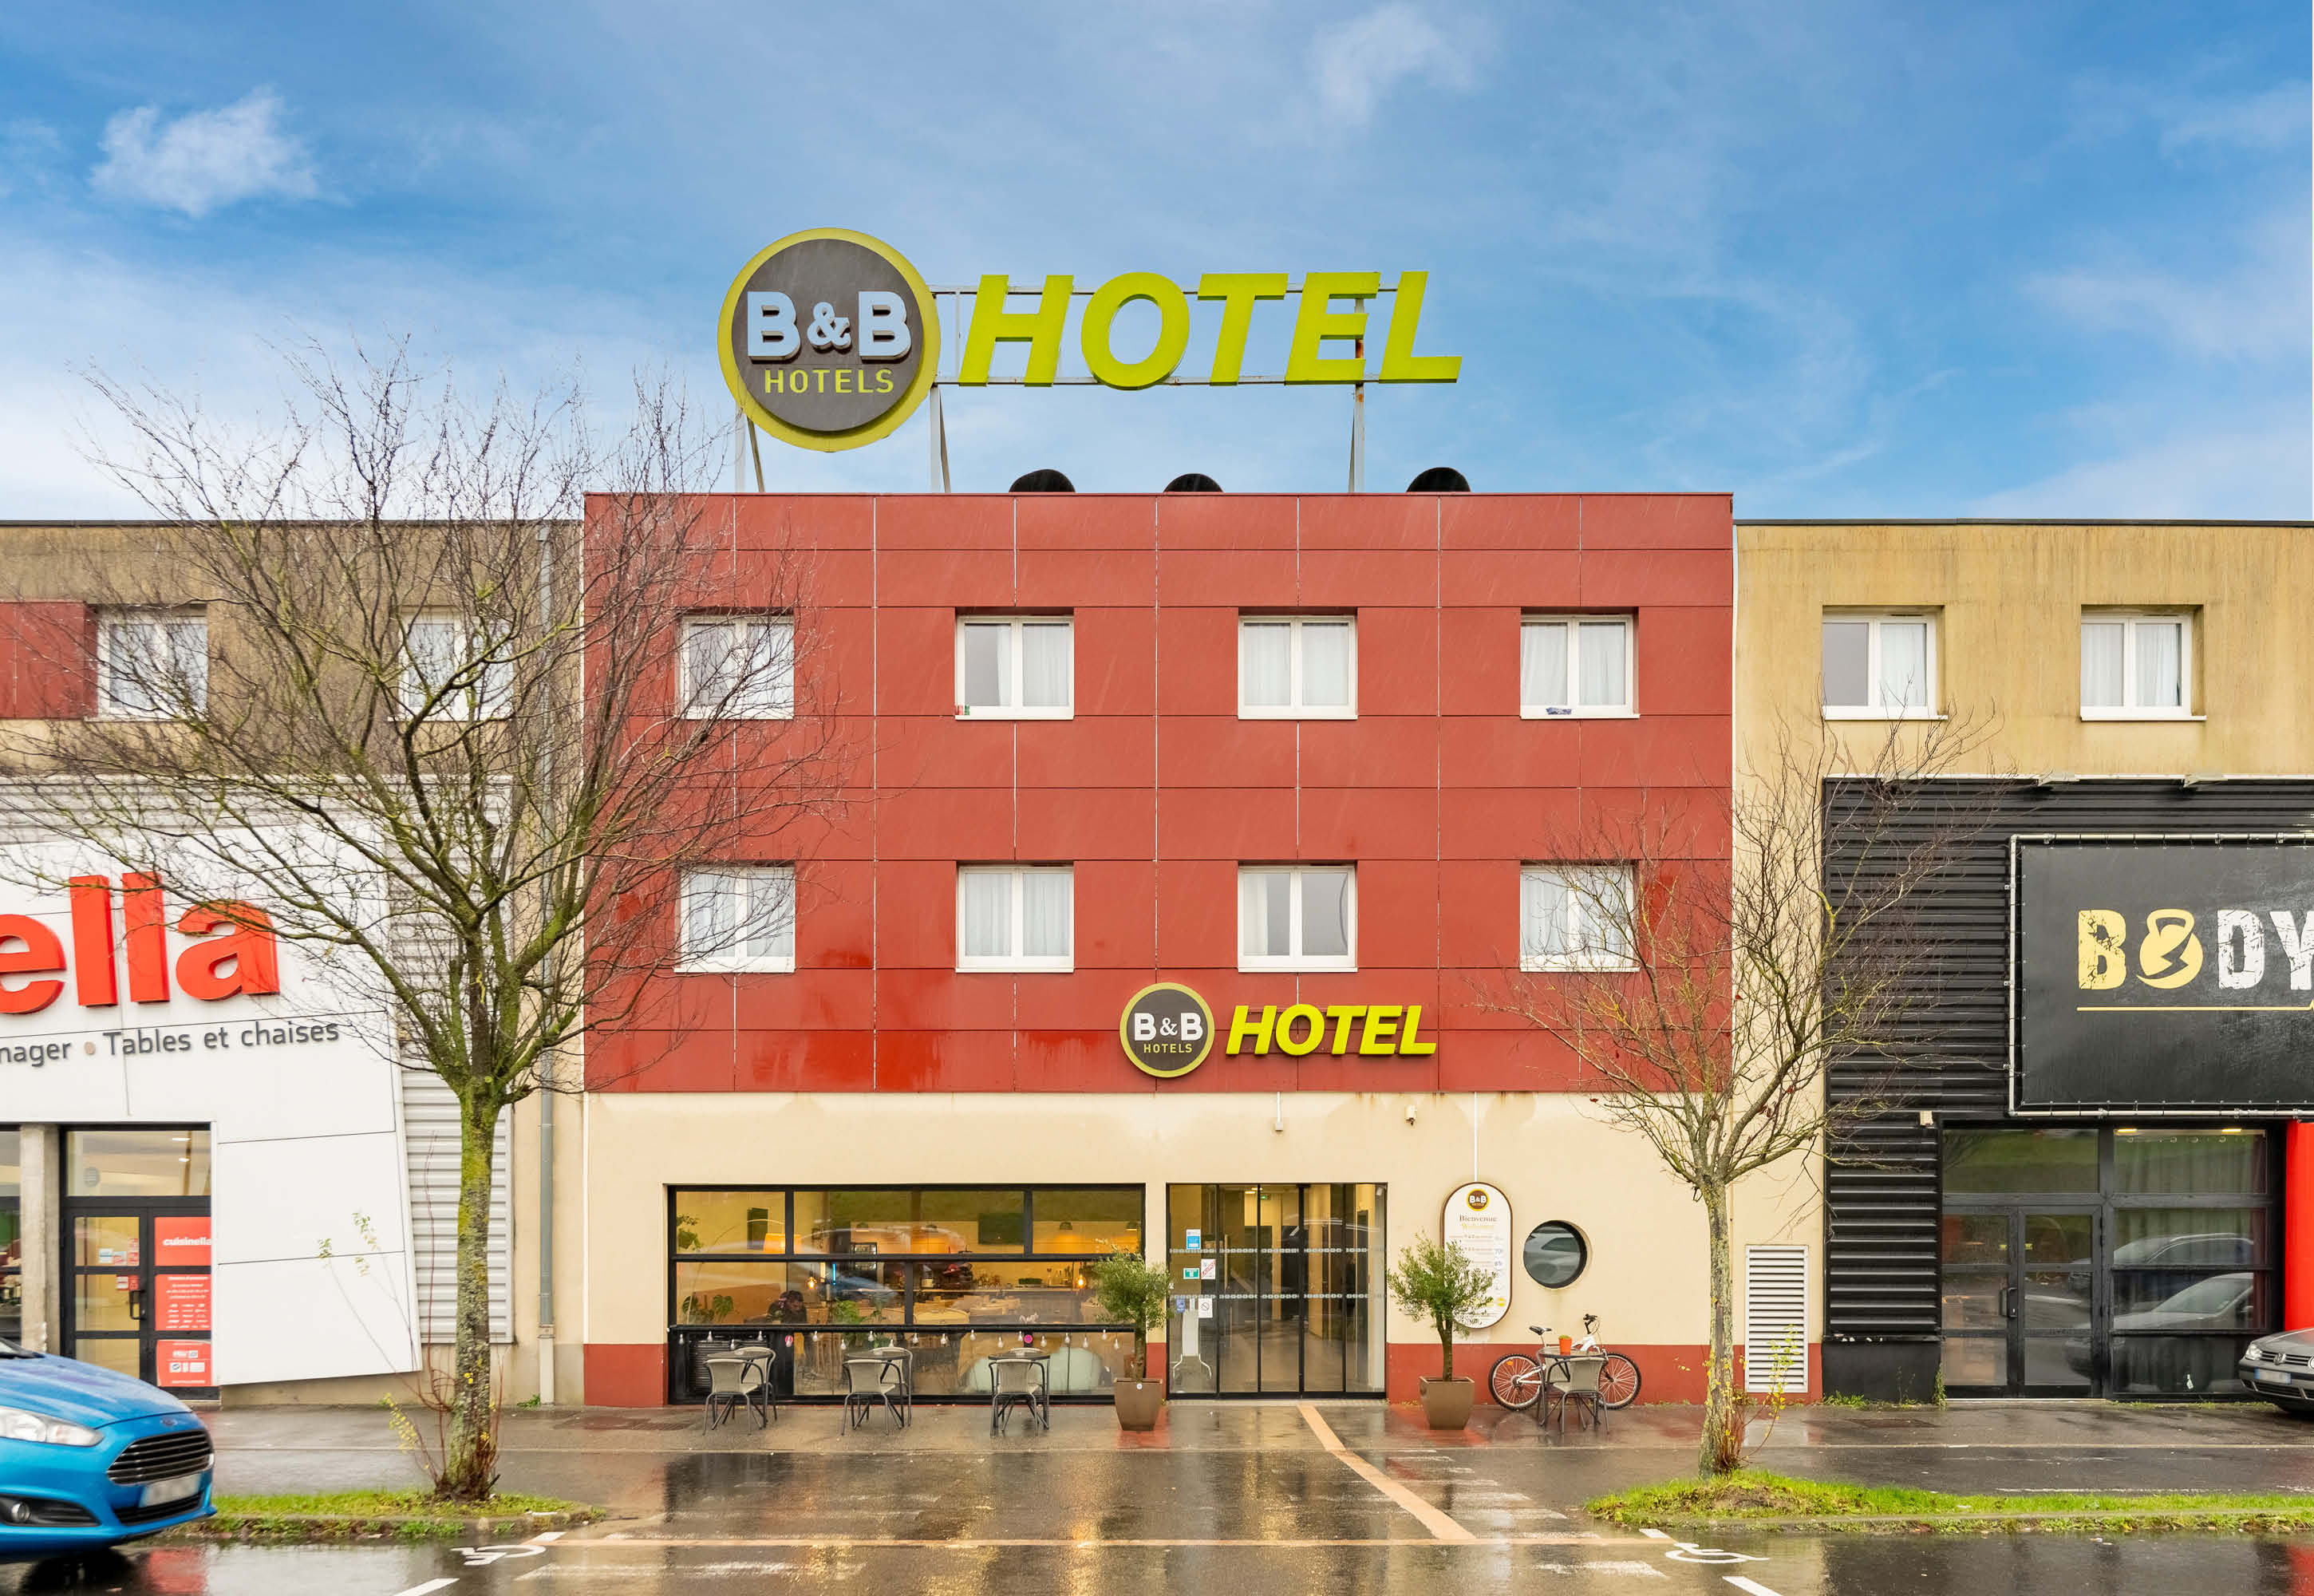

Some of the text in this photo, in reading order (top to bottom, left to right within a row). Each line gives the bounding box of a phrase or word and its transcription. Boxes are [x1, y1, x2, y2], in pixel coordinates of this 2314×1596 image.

[747, 290, 911, 361] B&B
[959, 271, 1462, 390] HOTEL
[765, 369, 894, 394] HOTELS
[103, 1029, 192, 1056] Tables
[203, 1027, 229, 1049] et
[240, 1021, 340, 1047] chaises
[1134, 1013, 1203, 1041] B&B
[1226, 1004, 1436, 1055] HOTEL
[1143, 1043, 1193, 1053] HOTELS
[1459, 1214, 1497, 1223] Bienvenue
